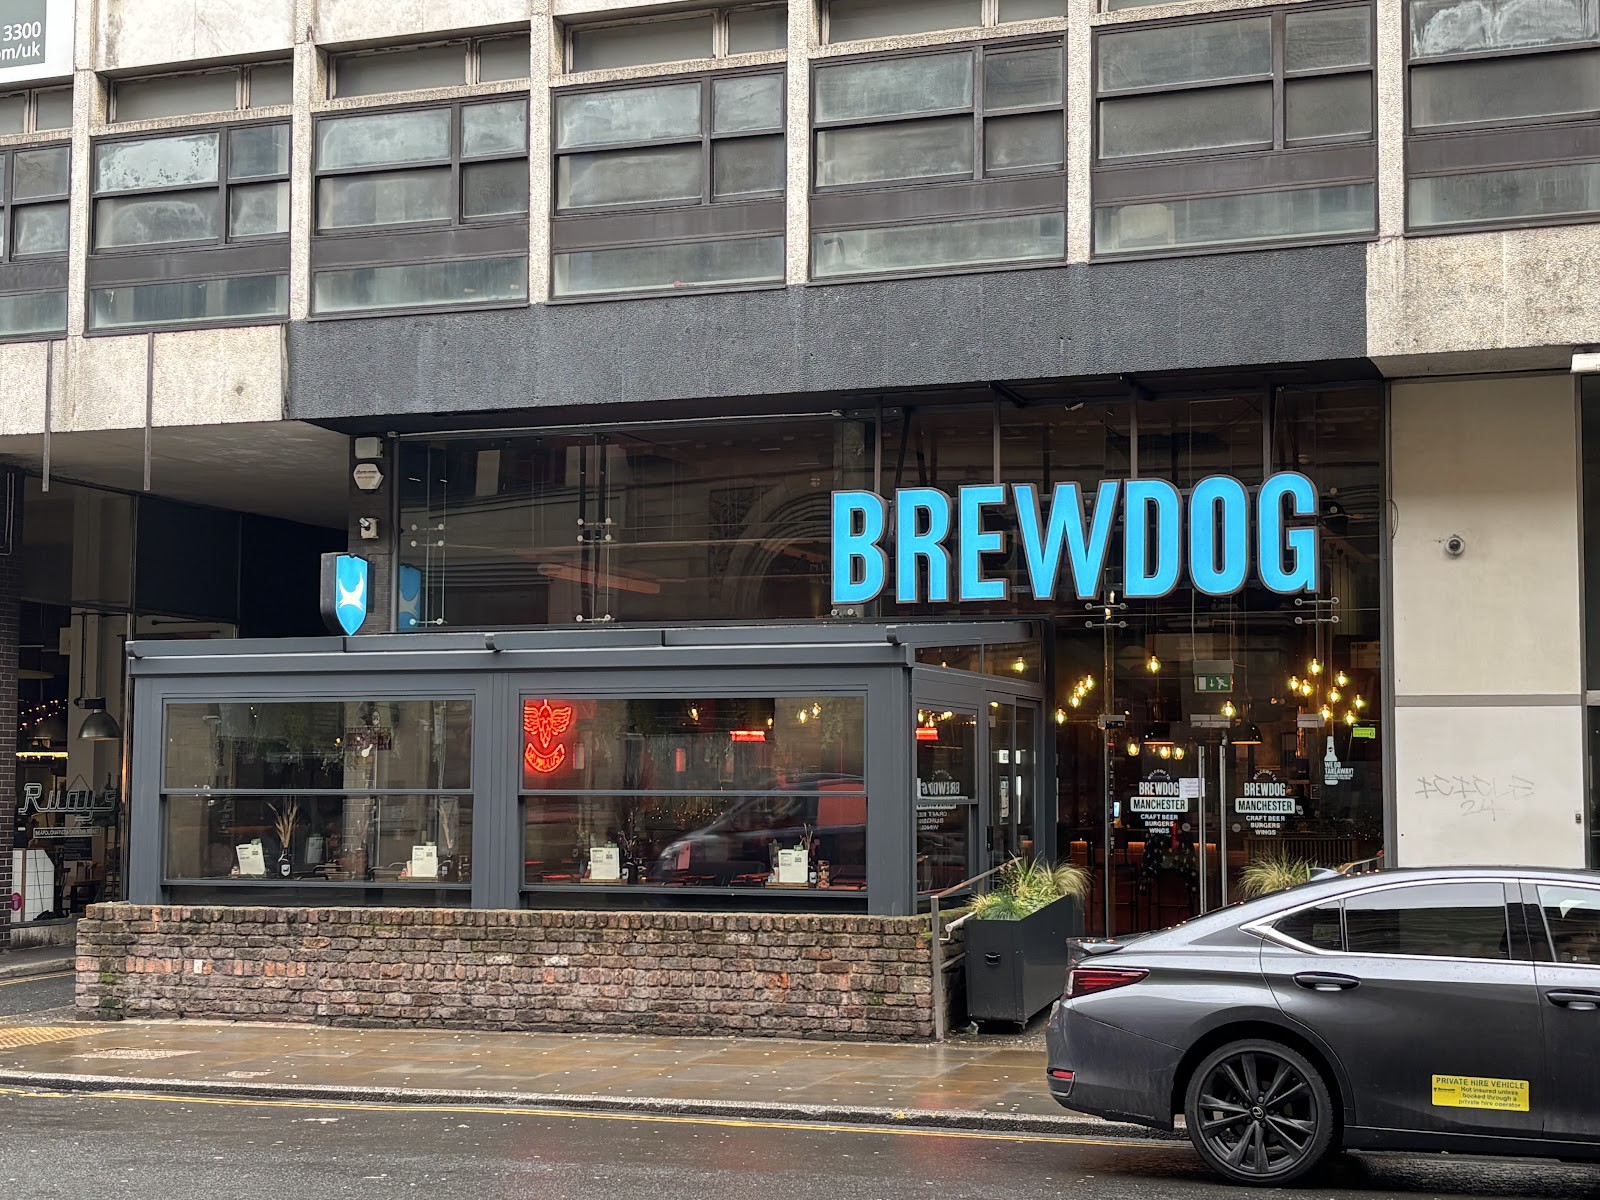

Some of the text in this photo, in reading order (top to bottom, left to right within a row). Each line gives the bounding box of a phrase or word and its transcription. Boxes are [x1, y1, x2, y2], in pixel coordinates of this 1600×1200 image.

[2, 21, 42, 42] 3300
[0, 41, 41, 60] m/uk
[831, 470, 1320, 605] BREWDOG
[1138, 781, 1179, 796] BREWDOG
[1243, 782, 1286, 797] BREWDOG
[1133, 799, 1186, 810] MANCHESTER
[1238, 800, 1292, 811] MANCHESTER
[1436, 1077, 1525, 1090] PRIVATE HIRE VEHICLE
[1472, 1086, 1497, 1095] insured
[1462, 1092, 1486, 1100] booked
[1486, 1094, 1512, 1103] through
